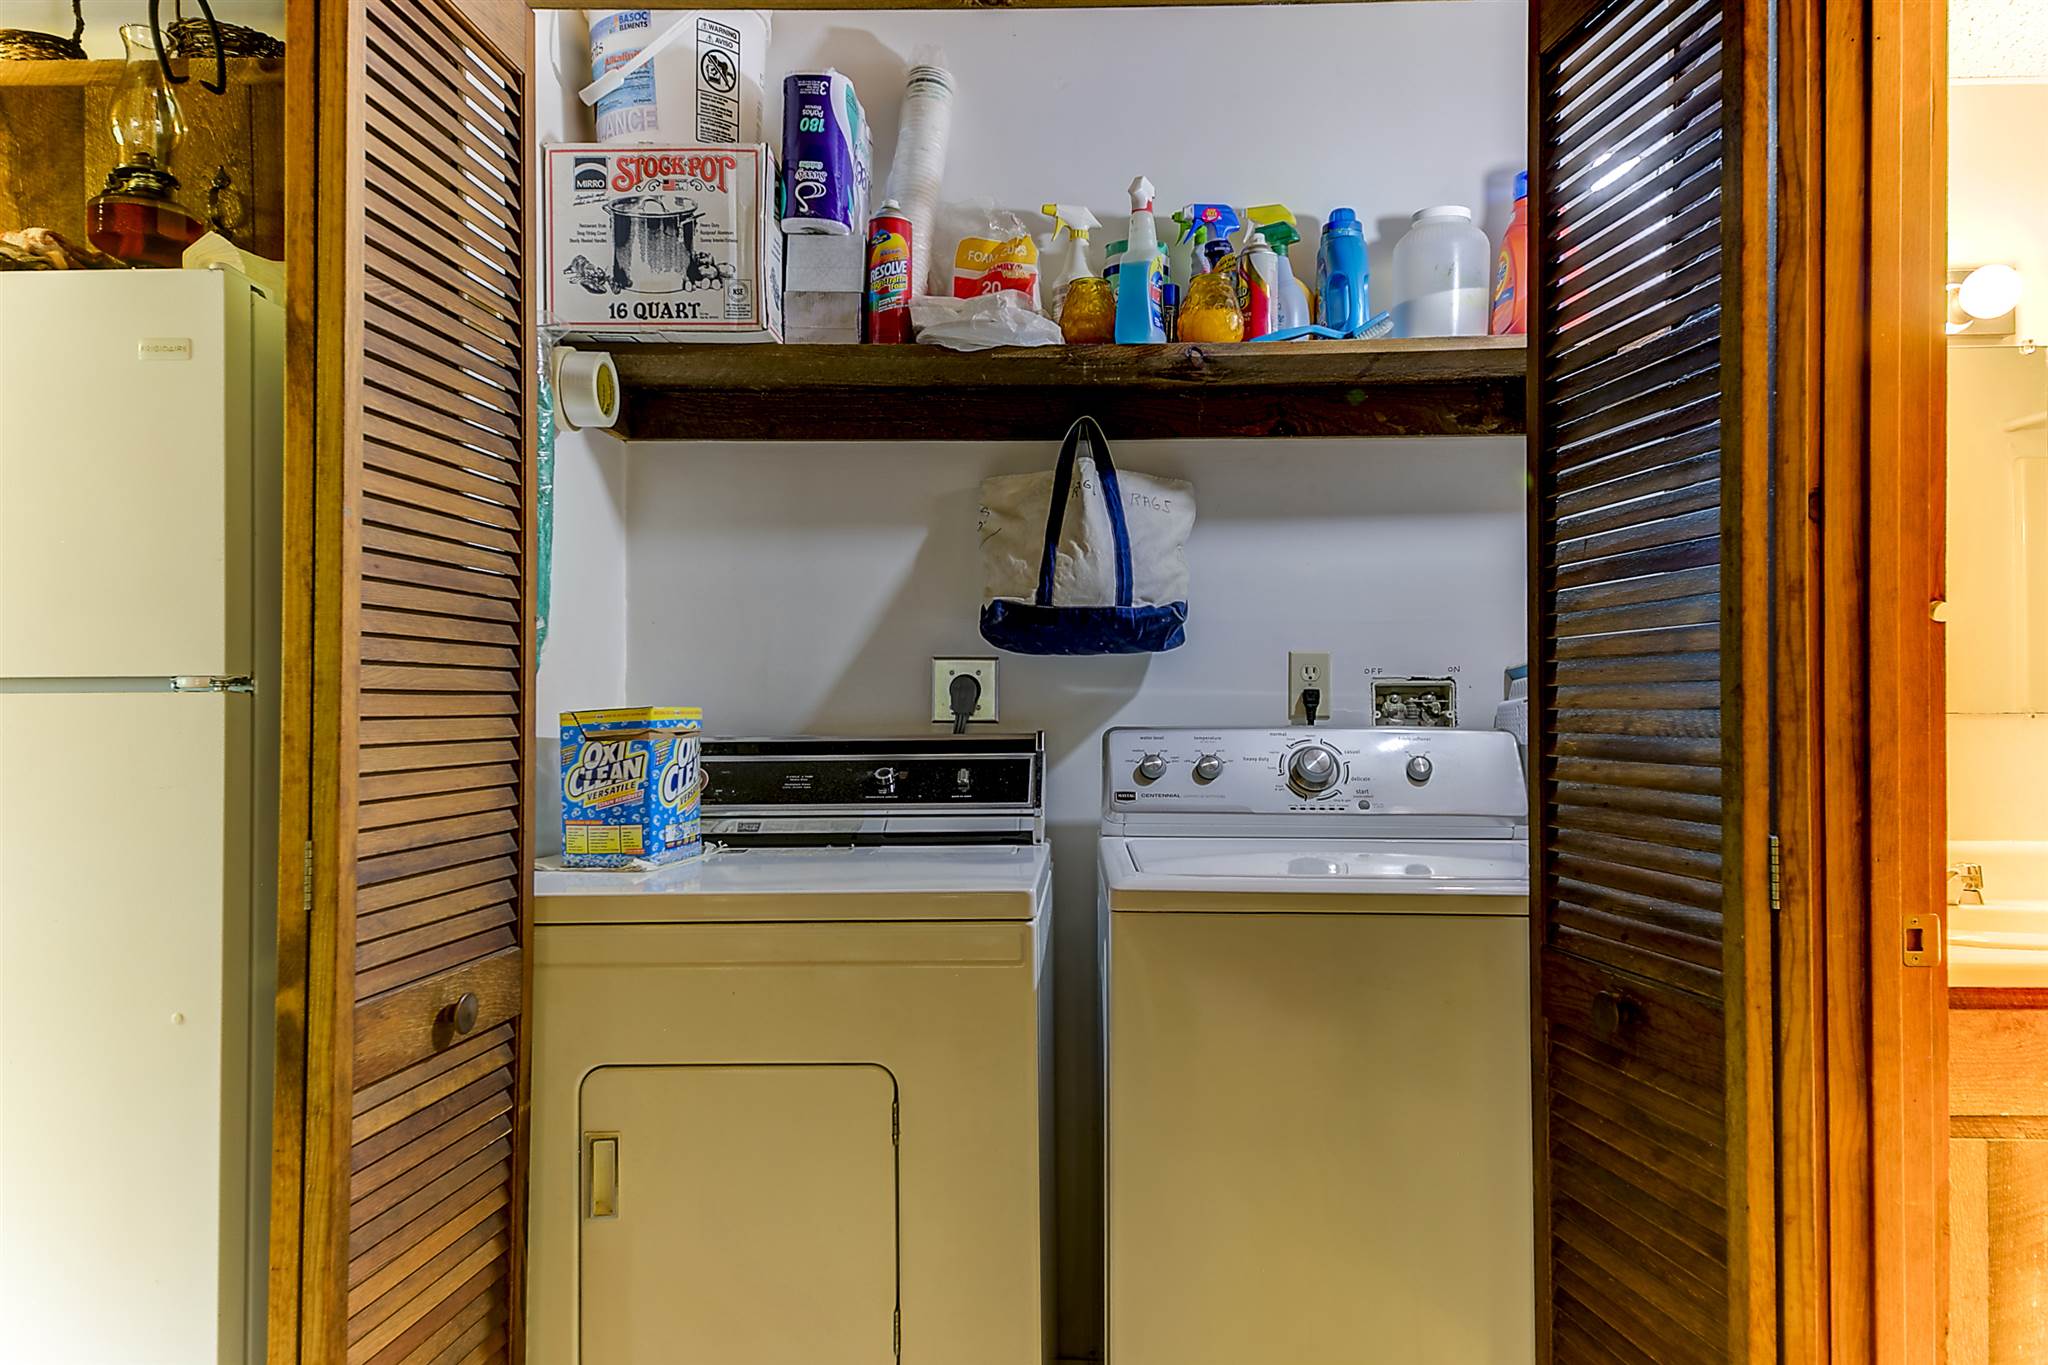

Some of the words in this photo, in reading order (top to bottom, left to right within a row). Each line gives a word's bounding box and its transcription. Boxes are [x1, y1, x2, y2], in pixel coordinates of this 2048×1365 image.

[708, 23, 737, 40] WARNING
[715, 37, 734, 49] AVISO
[819, 81, 829, 96] 3
[800, 117, 825, 133] 180
[576, 179, 605, 189] MIRRO
[870, 260, 908, 282] RESOLVE
[981, 281, 1002, 295] 20
[609, 302, 628, 319] 16
[633, 301, 701, 320] QUART
[1131, 493, 1171, 513] RAGS
[1364, 667, 1383, 675] OFF
[1447, 665, 1461, 673] ON
[583, 741, 625, 770] OXI
[569, 755, 645, 798] CLEAN
[586, 781, 636, 801] VERSATILE
